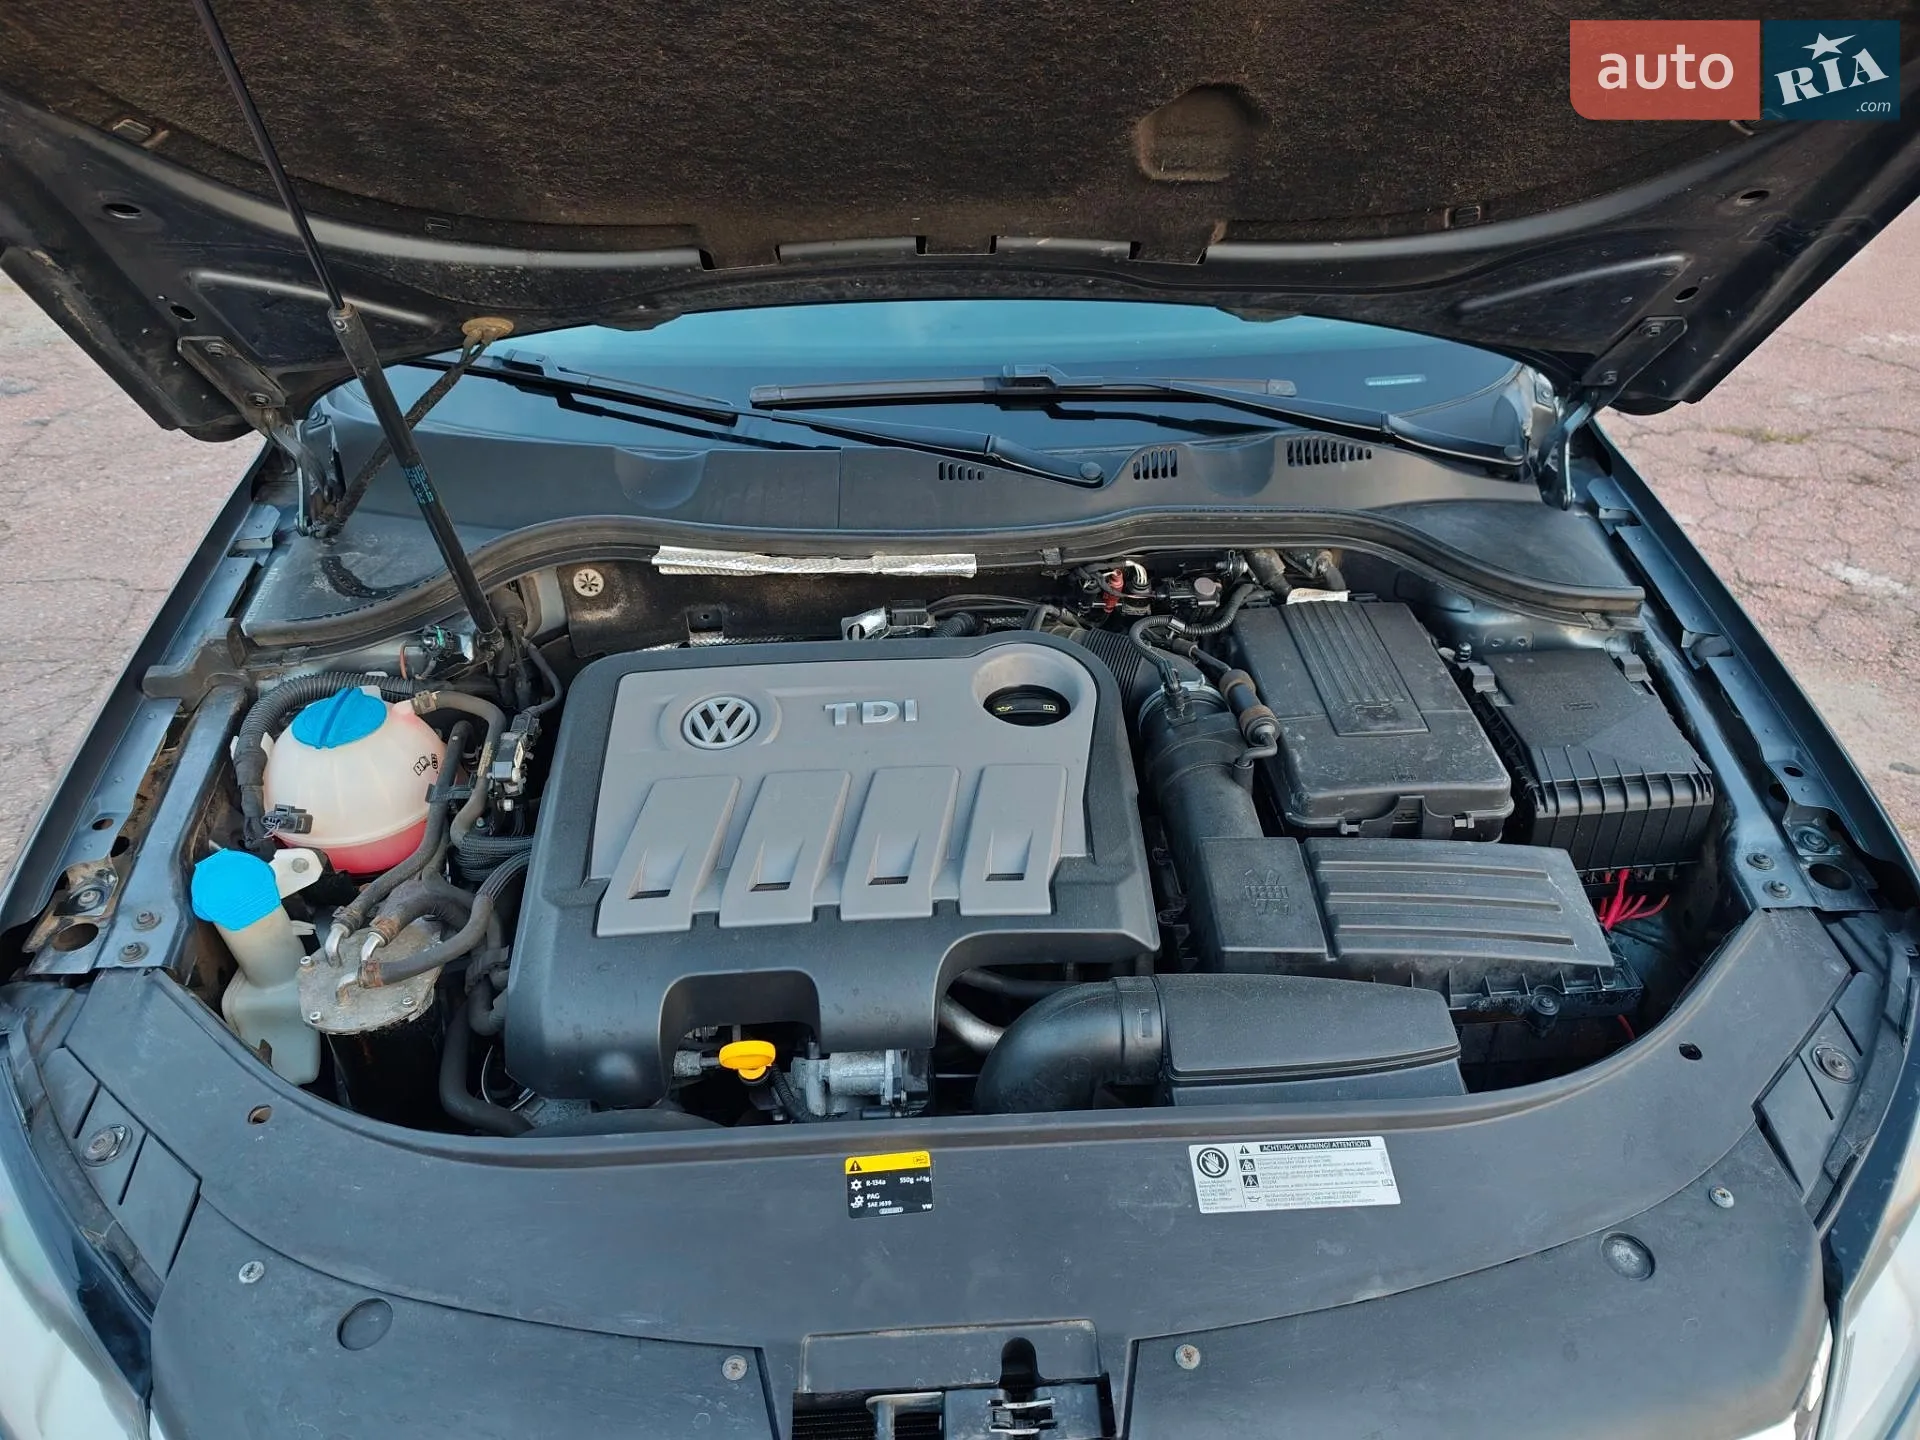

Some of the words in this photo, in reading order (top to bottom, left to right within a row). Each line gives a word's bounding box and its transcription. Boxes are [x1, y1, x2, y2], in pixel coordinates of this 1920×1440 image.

[683, 696, 759, 749] VW
[823, 698, 919, 727] TDI
[1262, 1143, 1296, 1152] ACHTUNG!
[1298, 1141, 1331, 1150] WARNING!
[1332, 1140, 1369, 1149] ATTENTION!
[866, 1192, 881, 1200] PAG
